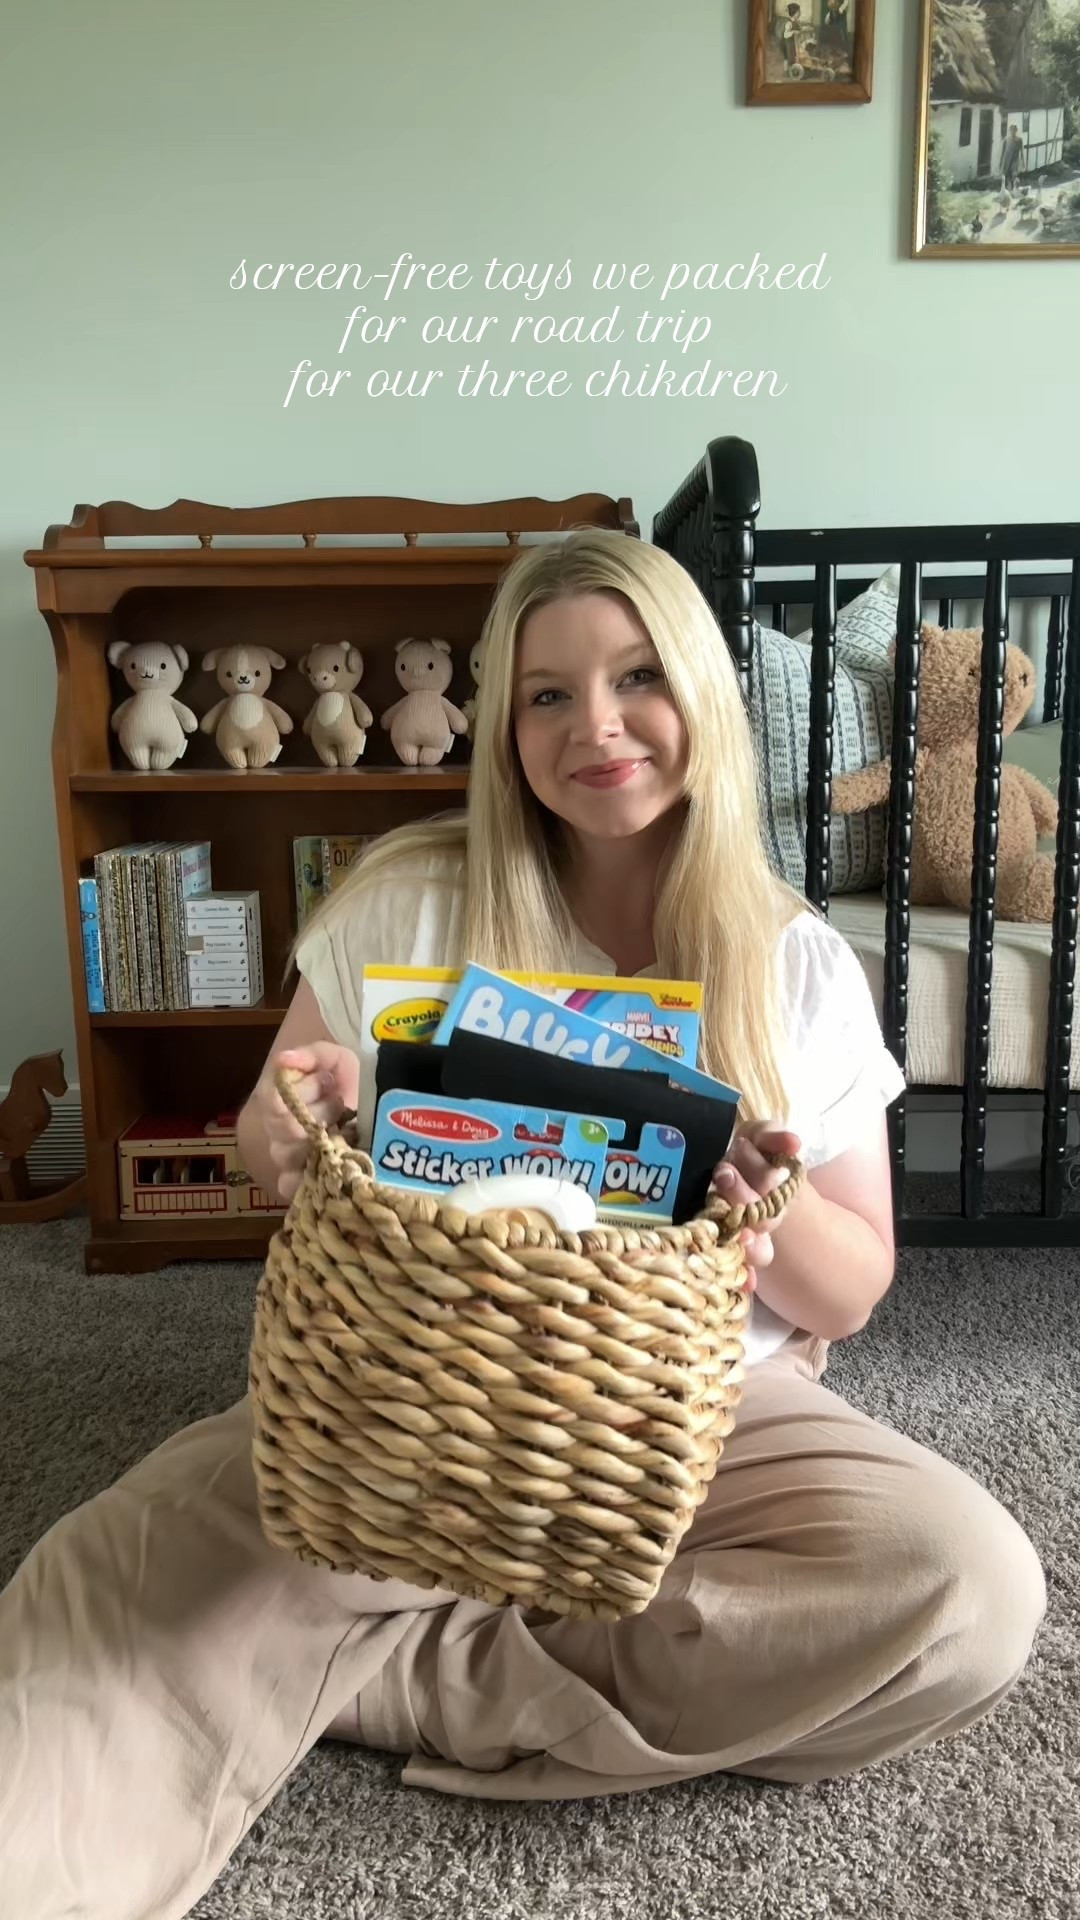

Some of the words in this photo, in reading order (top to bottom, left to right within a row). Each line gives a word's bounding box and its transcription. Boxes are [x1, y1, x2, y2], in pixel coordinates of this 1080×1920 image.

[386, 1009, 442, 1027] Crayola
[400, 1110, 449, 1130] Melissa
[452, 1120, 459, 1131] &
[461, 1119, 490, 1140] Doug
[588, 1123, 600, 1135] 3+
[666, 1129, 677, 1141] 3+
[381, 1141, 493, 1185] Sticker
[502, 1154, 595, 1190] WOW!
